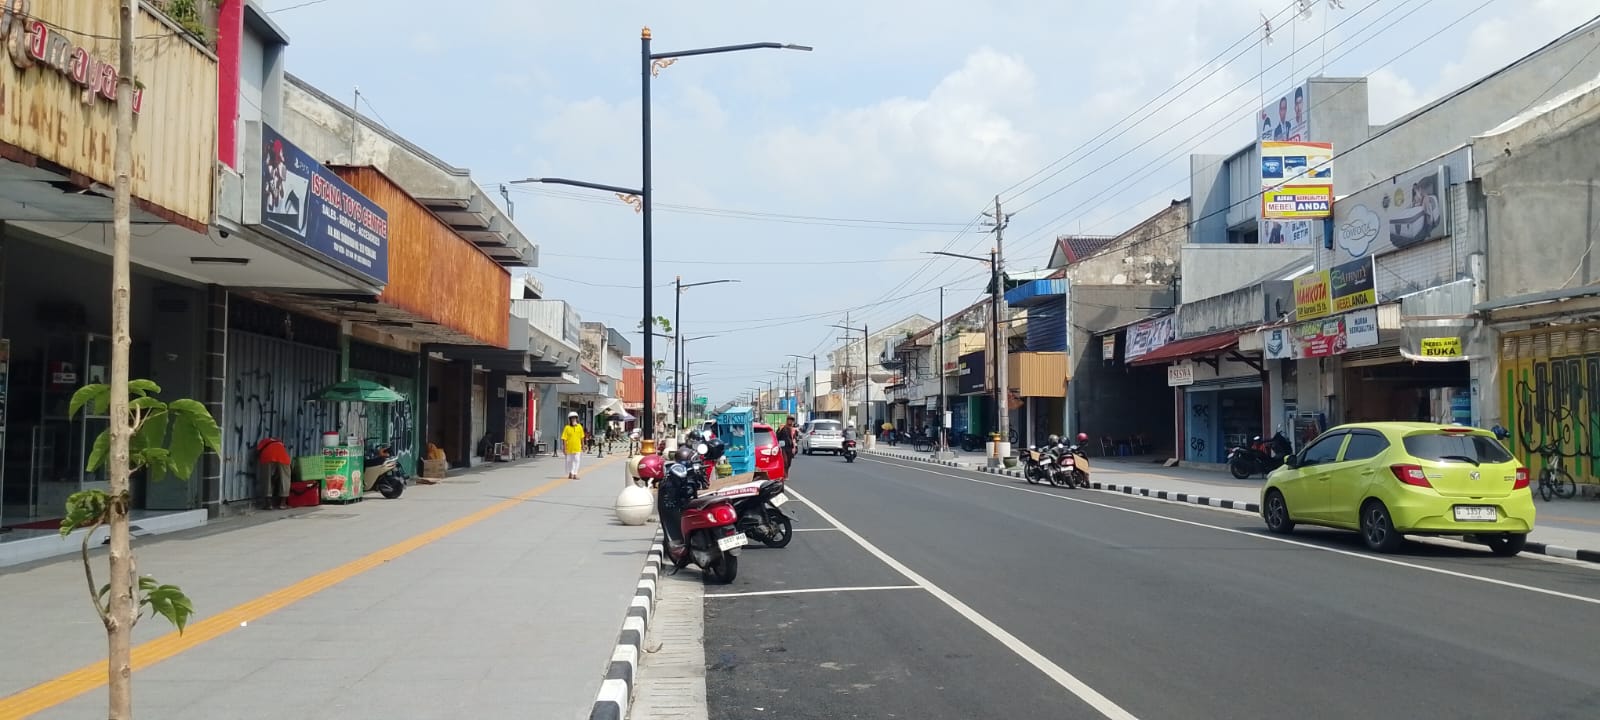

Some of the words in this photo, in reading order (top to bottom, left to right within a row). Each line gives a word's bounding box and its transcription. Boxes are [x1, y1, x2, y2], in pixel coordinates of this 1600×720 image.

[312, 171, 342, 210] ISTANA
[342, 192, 362, 223] TOYS
[362, 206, 387, 239] CENTRE
[1268, 203, 1293, 211] MEBEL
[1297, 202, 1327, 211] ANDA
[322, 203, 337, 221] SALES
[339, 214, 356, 232] SERVICE
[1296, 282, 1327, 305] MAHKOTA
[1337, 298, 1352, 311] MEBEL
[1351, 293, 1369, 307] ANDA
[1426, 347, 1456, 356] BUKA
[1173, 367, 1191, 379] SISWA
[335, 447, 349, 457] Teh
